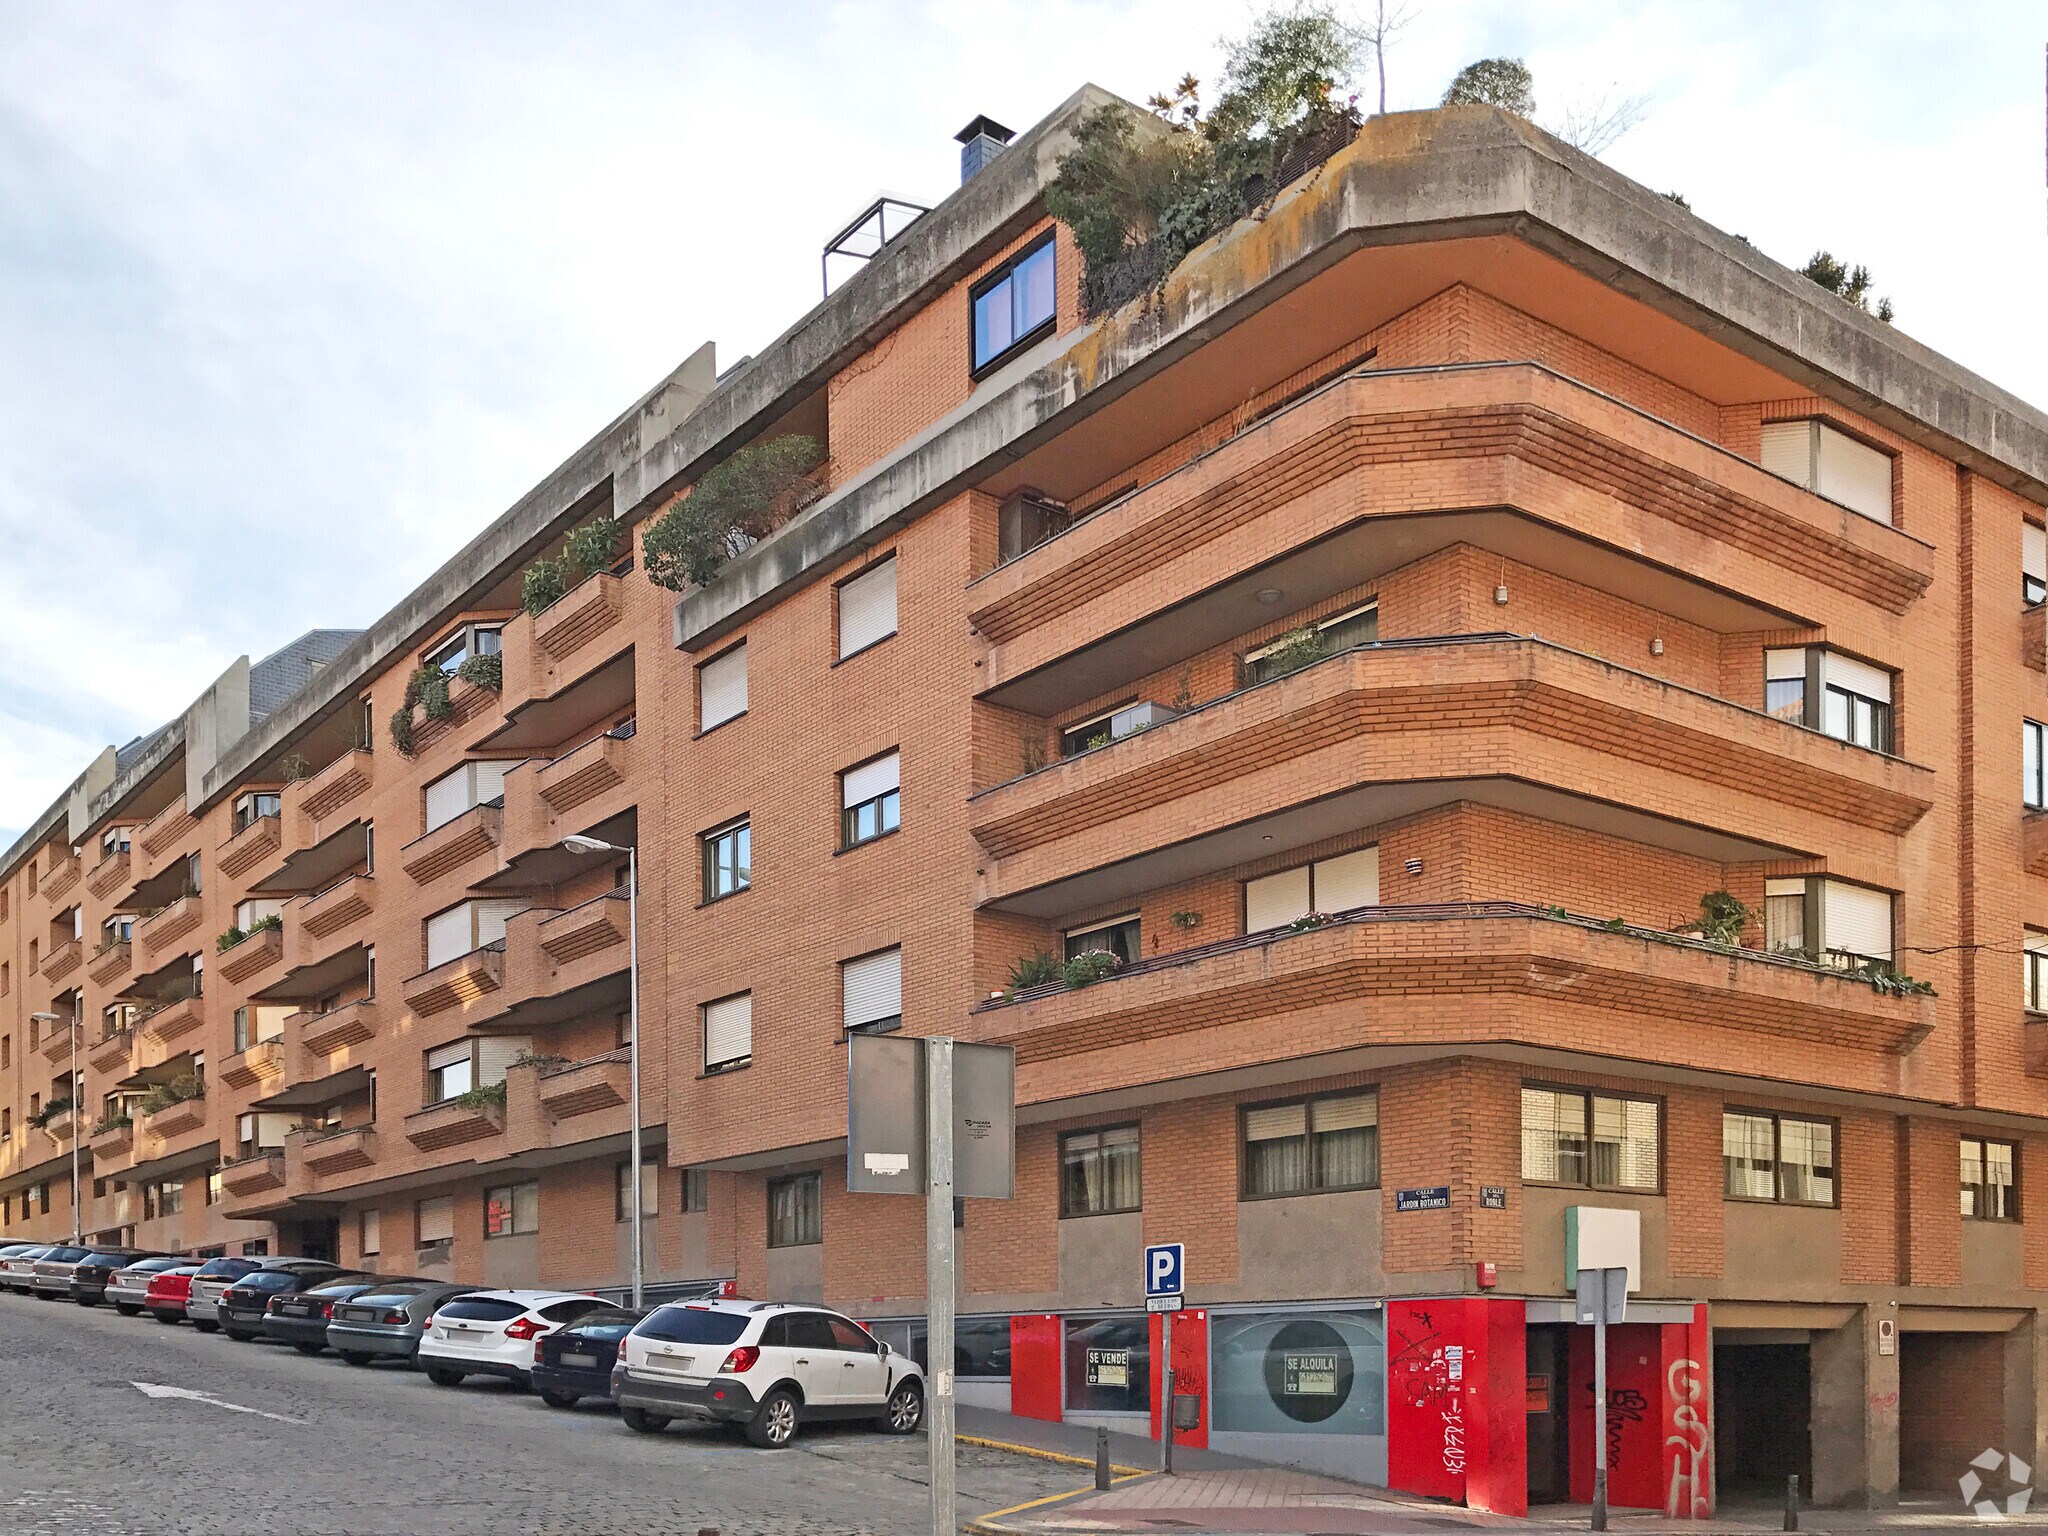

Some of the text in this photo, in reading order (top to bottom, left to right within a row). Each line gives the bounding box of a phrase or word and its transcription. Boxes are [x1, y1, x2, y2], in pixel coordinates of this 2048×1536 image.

[1400, 1197, 1446, 1209] JARDIN BOTANICO
[1486, 1197, 1502, 1207] ROBLE
[1152, 1251, 1175, 1290] P
[1089, 1352, 1127, 1365] SE VENDE
[1287, 1358, 1334, 1370] SE ALQUILA
